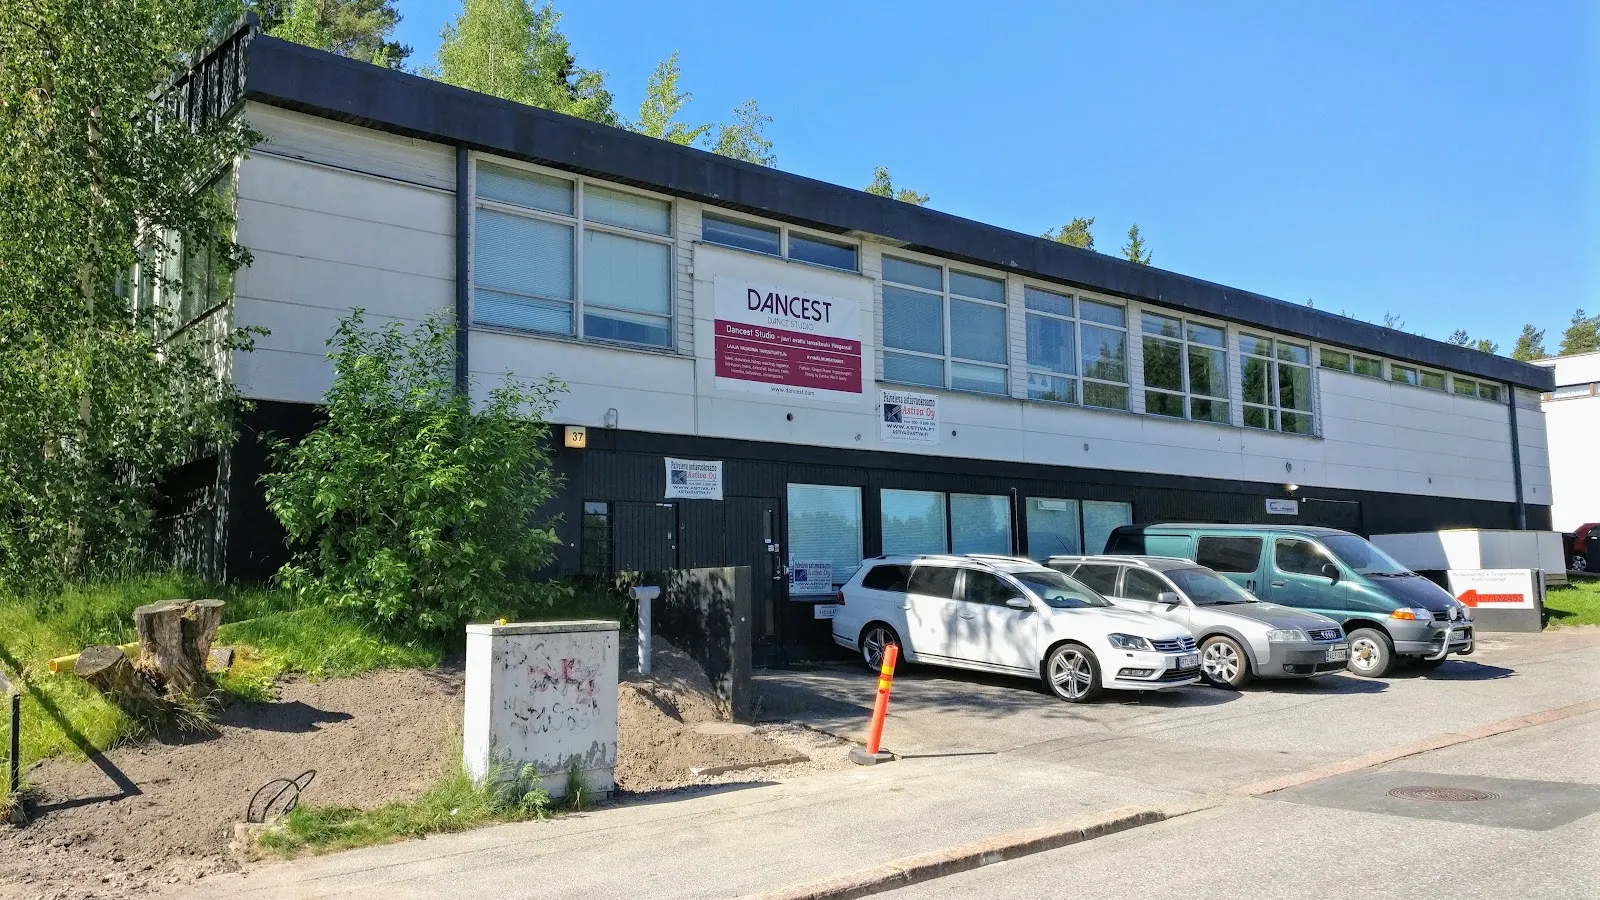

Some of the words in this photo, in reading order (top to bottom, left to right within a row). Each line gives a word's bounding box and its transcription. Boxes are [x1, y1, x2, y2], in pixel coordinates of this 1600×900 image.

[747, 288, 832, 323] DANCEST
[767, 316, 789, 328] DANCE
[790, 320, 814, 331] STUDIO
[726, 324, 753, 336] Dancest
[754, 329, 776, 340] Studio
[770, 386, 815, 397] www.dancest.com
[901, 405, 924, 416] Astiva
[926, 407, 936, 420] Oy
[572, 431, 584, 442] 37
